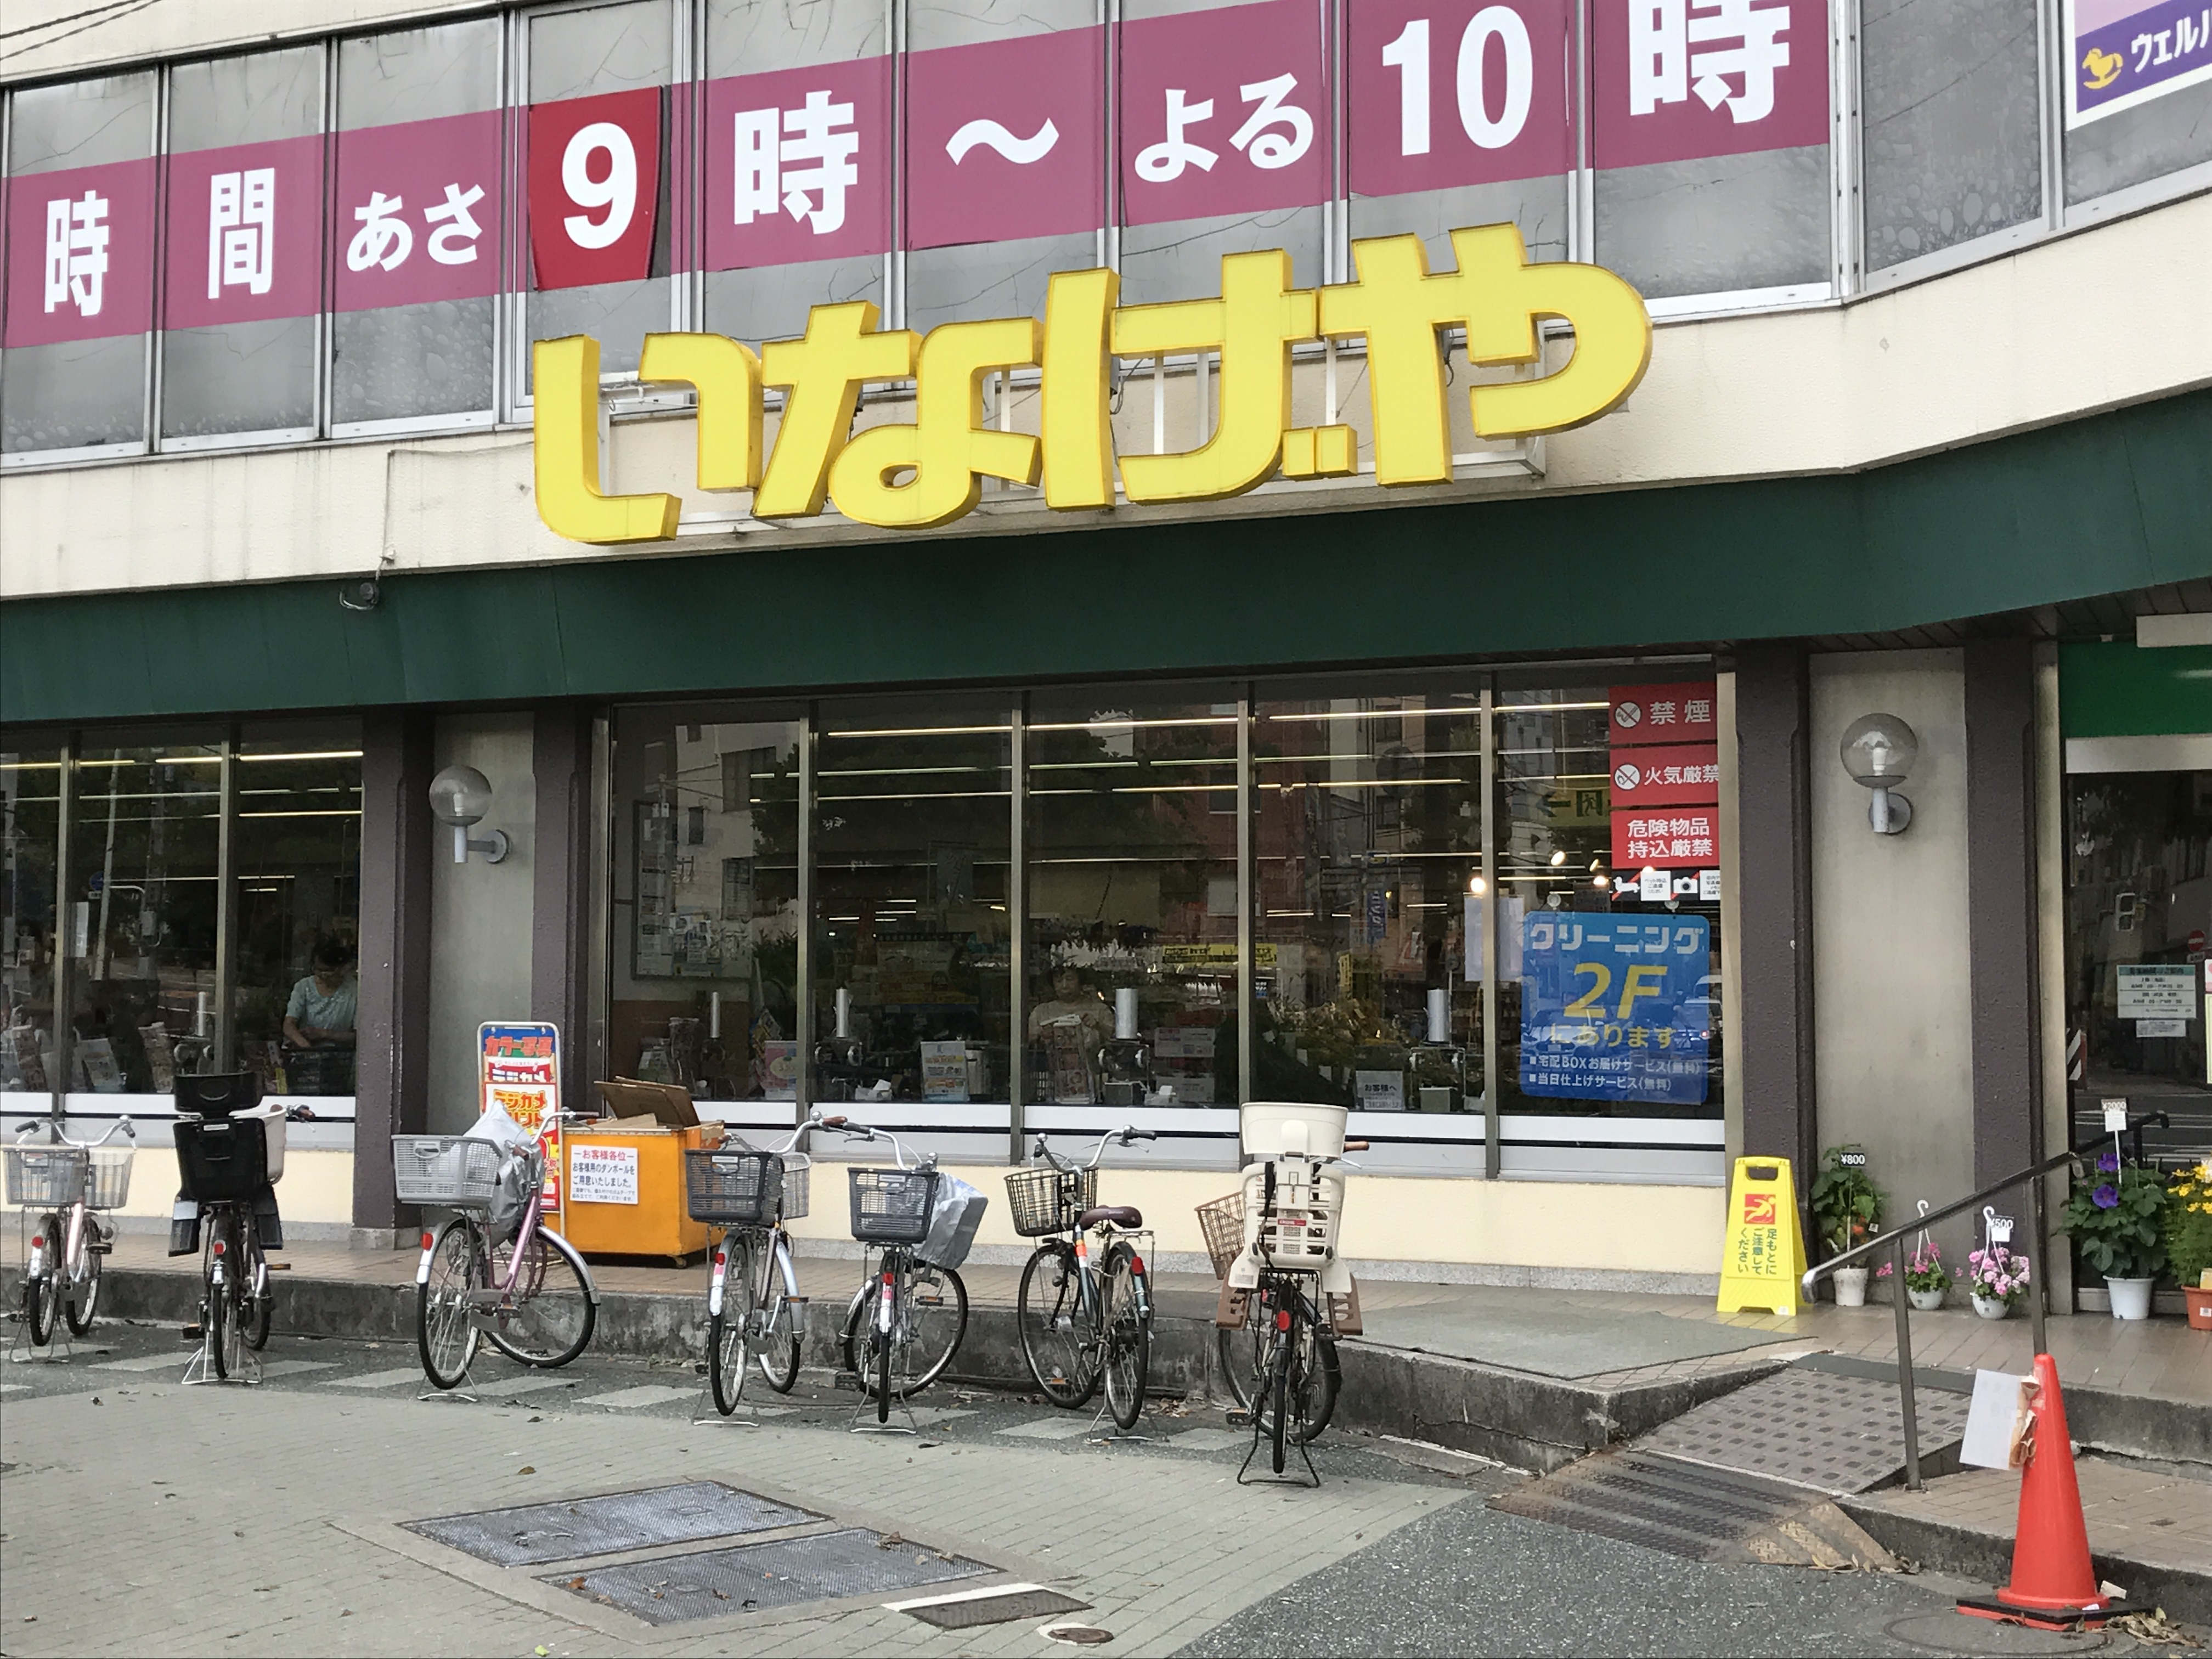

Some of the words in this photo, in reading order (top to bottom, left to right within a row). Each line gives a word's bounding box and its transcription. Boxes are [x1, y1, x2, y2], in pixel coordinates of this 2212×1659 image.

[533, 222, 1652, 544] いなげや
[1650, 699, 1711, 725] 禁煙
[1644, 765, 1719, 785] 火気厳禁
[1628, 818, 1709, 838] 危険物品
[1628, 838, 1712, 859] 持込厳禁
[1530, 924, 1704, 954] クリーニング
[1564, 962, 1668, 1019] 2F
[486, 1036, 553, 1056] カラー写真
[1550, 1023, 1677, 1048] にあります
[1841, 1154, 1865, 1164] ¥800
[573, 1176, 631, 1188] ご用意いたしました。
[1737, 1227, 1750, 1273] ください
[1751, 1227, 1764, 1276] ご注意して
[1765, 1228, 1778, 1275] 足もとに
